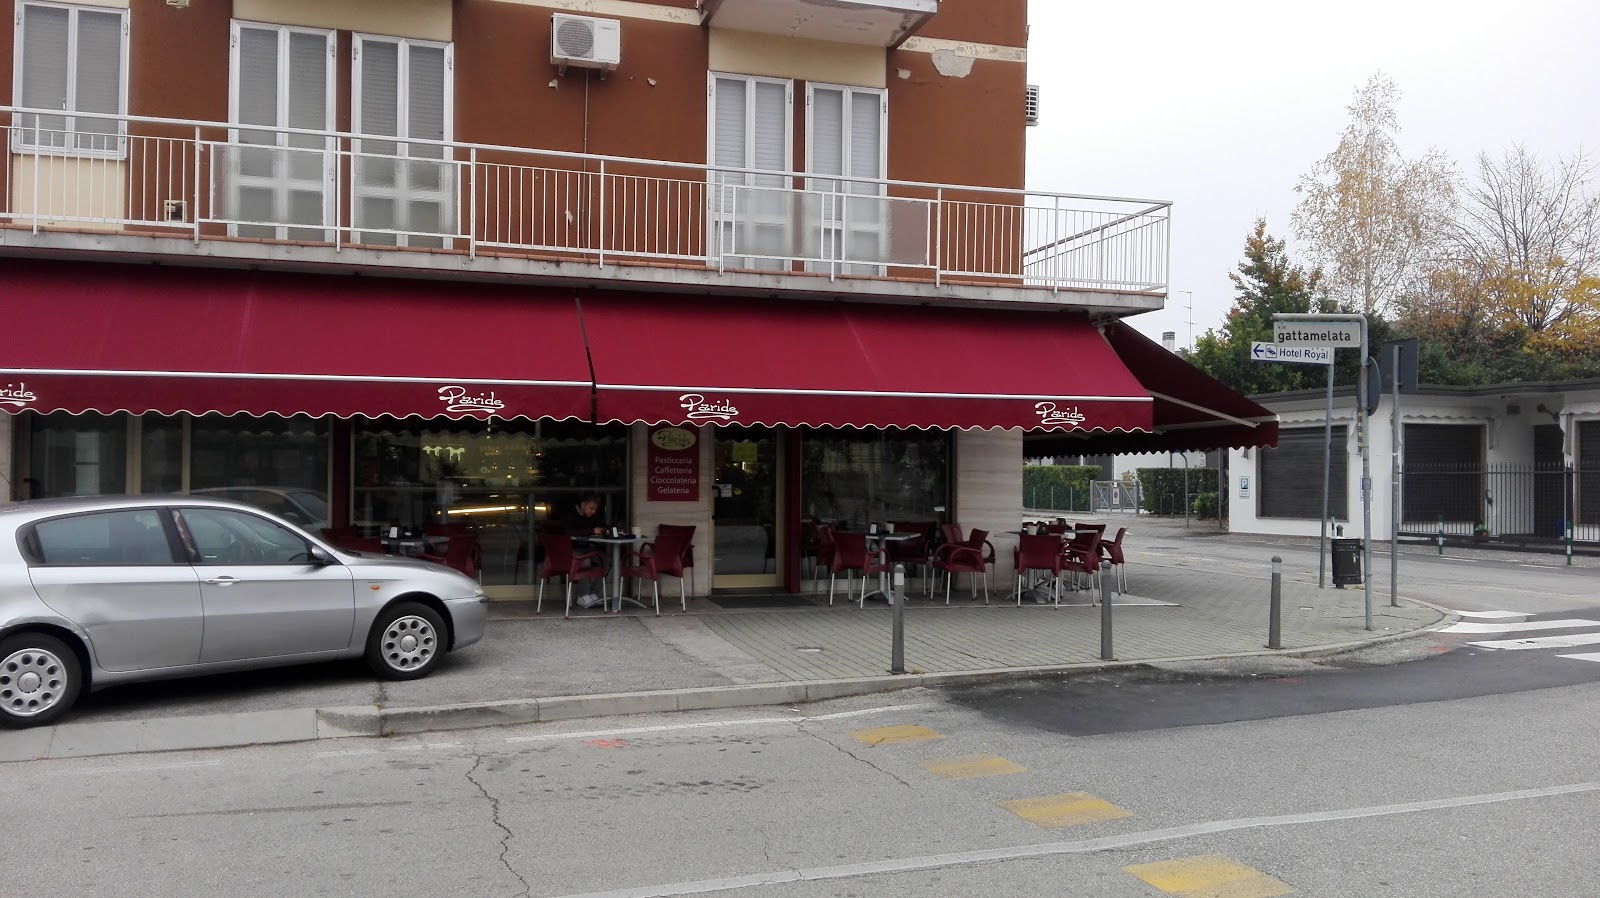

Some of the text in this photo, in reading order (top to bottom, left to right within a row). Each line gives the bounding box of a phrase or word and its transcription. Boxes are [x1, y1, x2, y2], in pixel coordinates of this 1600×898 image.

[1278, 330, 1351, 343] gattamelata
[1279, 348, 1329, 361] Hotel Royal
[437, 385, 506, 414] Paride
[679, 393, 739, 420] Paride
[1034, 401, 1086, 426] Paride
[658, 430, 691, 447] Paride
[655, 456, 693, 465] Pasticceria
[654, 466, 693, 474] Caffetteria
[650, 476, 697, 484] Cioccolateria
[657, 486, 690, 494] Gelateria
